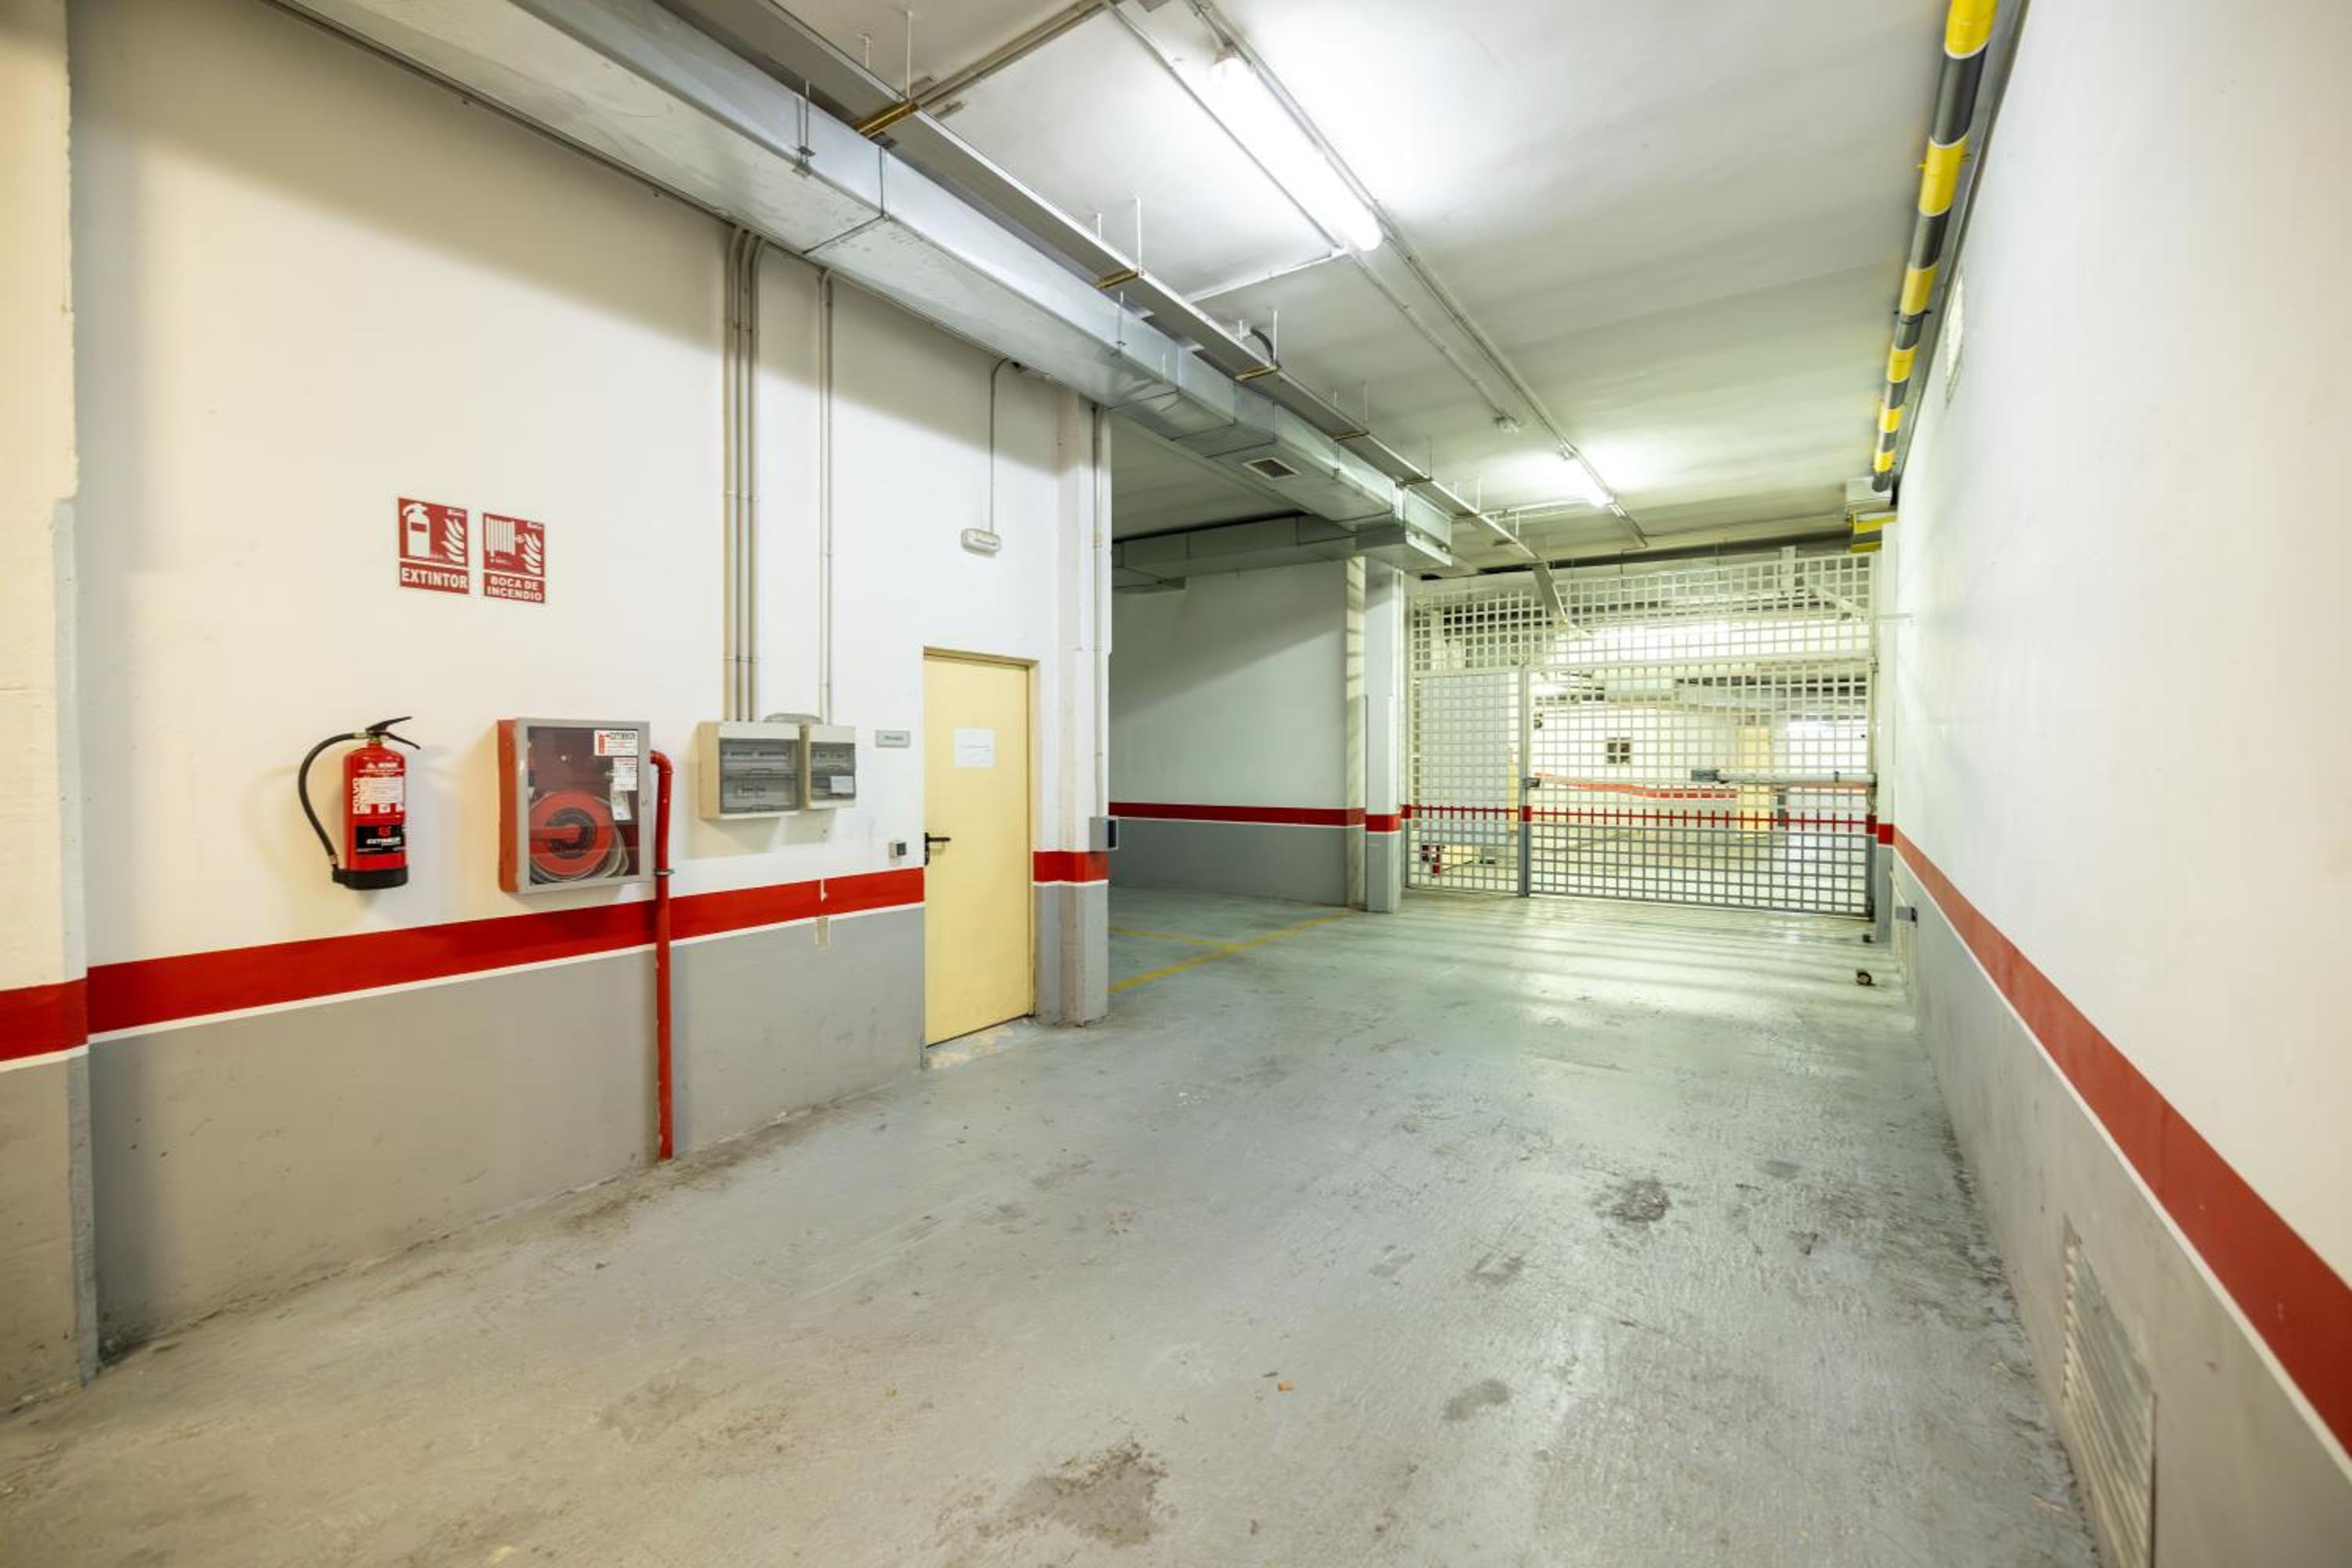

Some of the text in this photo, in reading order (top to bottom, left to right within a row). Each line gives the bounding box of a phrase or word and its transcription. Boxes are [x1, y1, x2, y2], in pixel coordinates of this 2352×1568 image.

[401, 567, 468, 589] EXTINTOR
[490, 575, 540, 590] BOCA DE
[487, 586, 543, 601] INCENDIO
